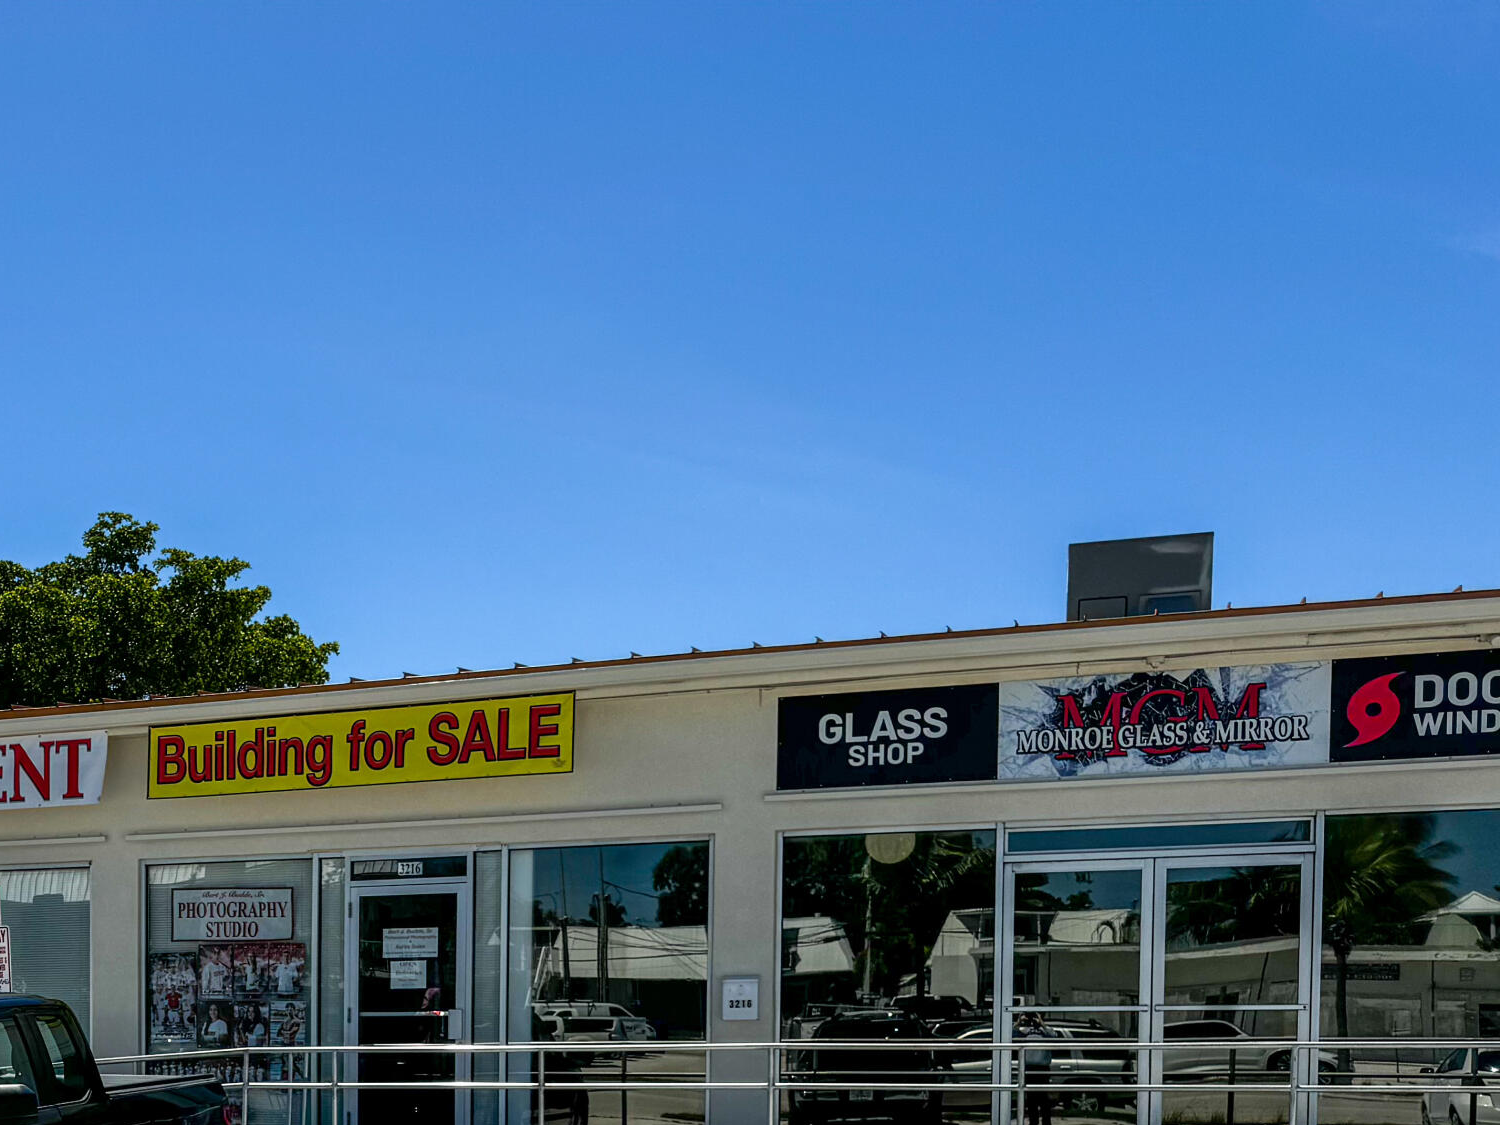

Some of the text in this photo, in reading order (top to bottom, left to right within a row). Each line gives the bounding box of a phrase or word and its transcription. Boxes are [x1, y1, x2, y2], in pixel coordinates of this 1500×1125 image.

[818, 707, 948, 745] GLASS
[1056, 682, 1267, 759] MGM
[1413, 709, 1500, 737] WIND
[156, 703, 561, 786] Building for SALE
[1016, 715, 1310, 754] MONROE GLASS & MIRROR
[847, 741, 924, 767] SHOP
[399, 863, 421, 875] 3216
[178, 901, 288, 919] PHOTOGRAPHY
[206, 920, 259, 938] STUDIO
[729, 1000, 752, 1008] 3216
